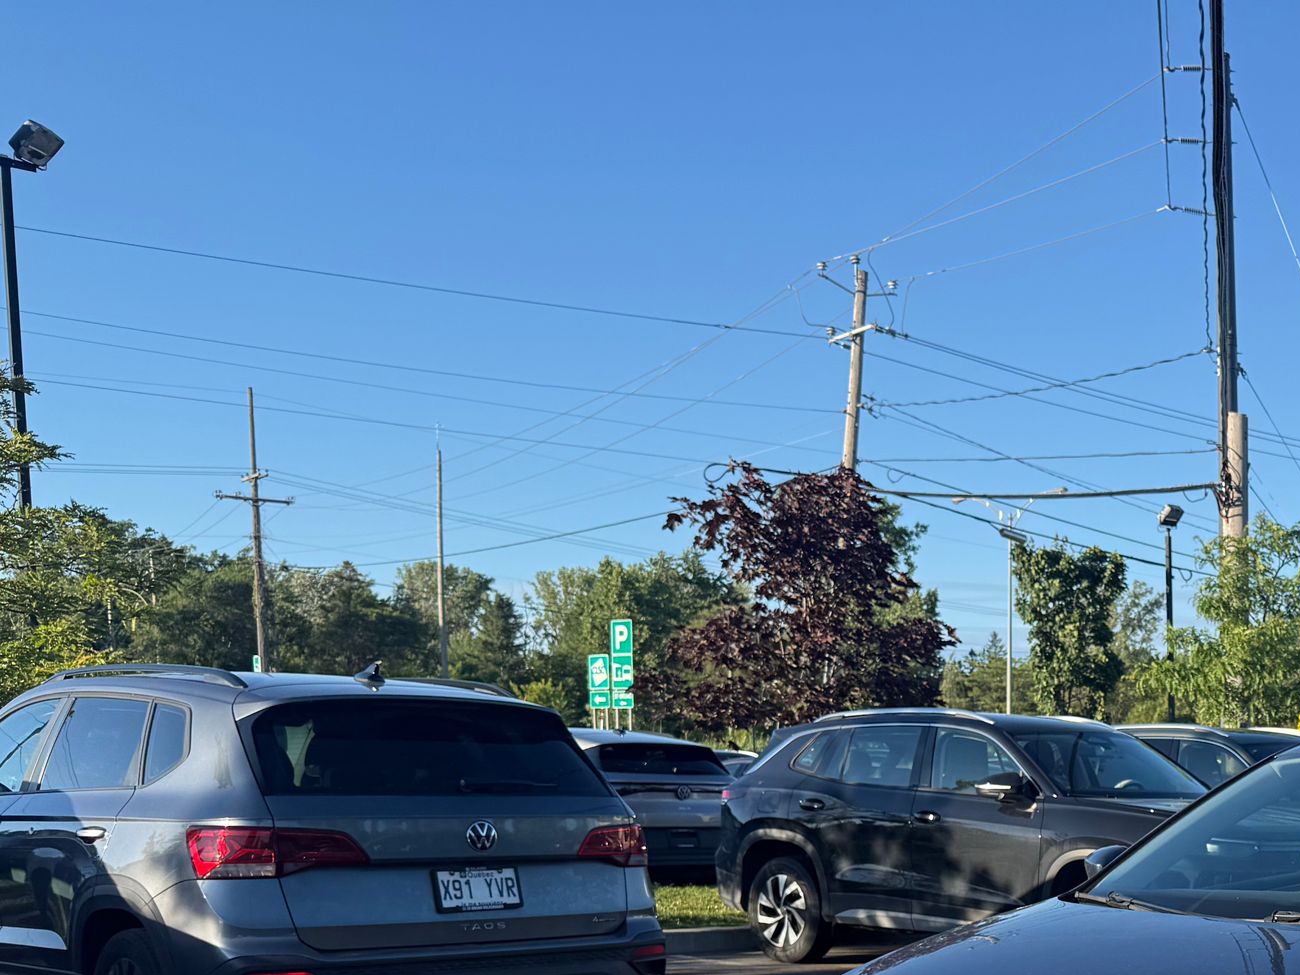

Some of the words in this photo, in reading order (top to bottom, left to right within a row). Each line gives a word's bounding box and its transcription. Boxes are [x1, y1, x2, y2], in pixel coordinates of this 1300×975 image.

[615, 625, 628, 650] P
[466, 820, 498, 852] VW
[440, 879, 474, 901] X91
[484, 876, 517, 899] YVR
[460, 921, 506, 931] TAOS
